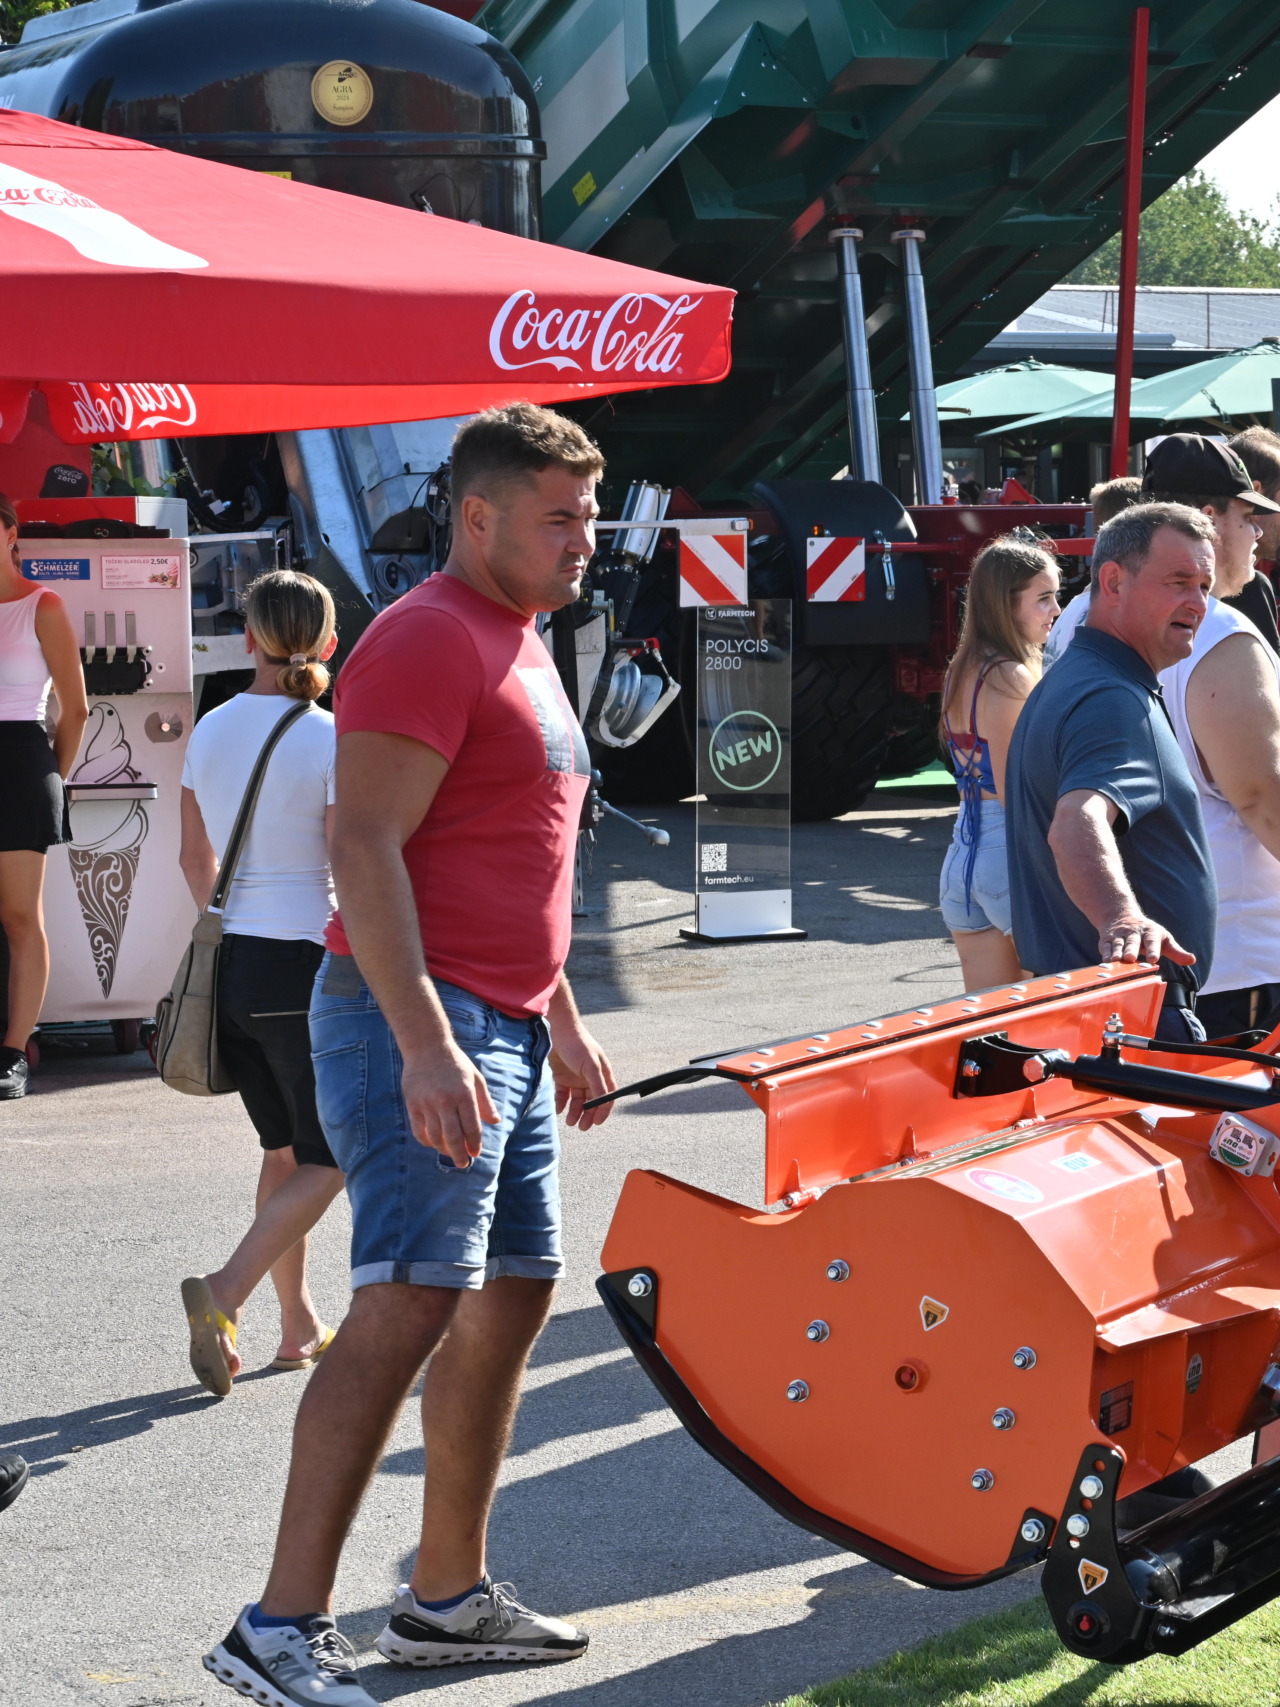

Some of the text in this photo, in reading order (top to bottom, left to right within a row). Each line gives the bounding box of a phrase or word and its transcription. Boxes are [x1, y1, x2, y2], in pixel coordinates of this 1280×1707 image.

[489, 289, 704, 374] Coca-Cola
[57, 475, 77, 484] zero
[30, 560, 79, 576] SCHMELZER
[718, 610, 755, 618] FARMTECH
[706, 639, 768, 653] POLYCIS
[705, 656, 742, 670] 2800
[715, 730, 772, 771] NEW
[704, 874, 754, 885] farmtech.eu
